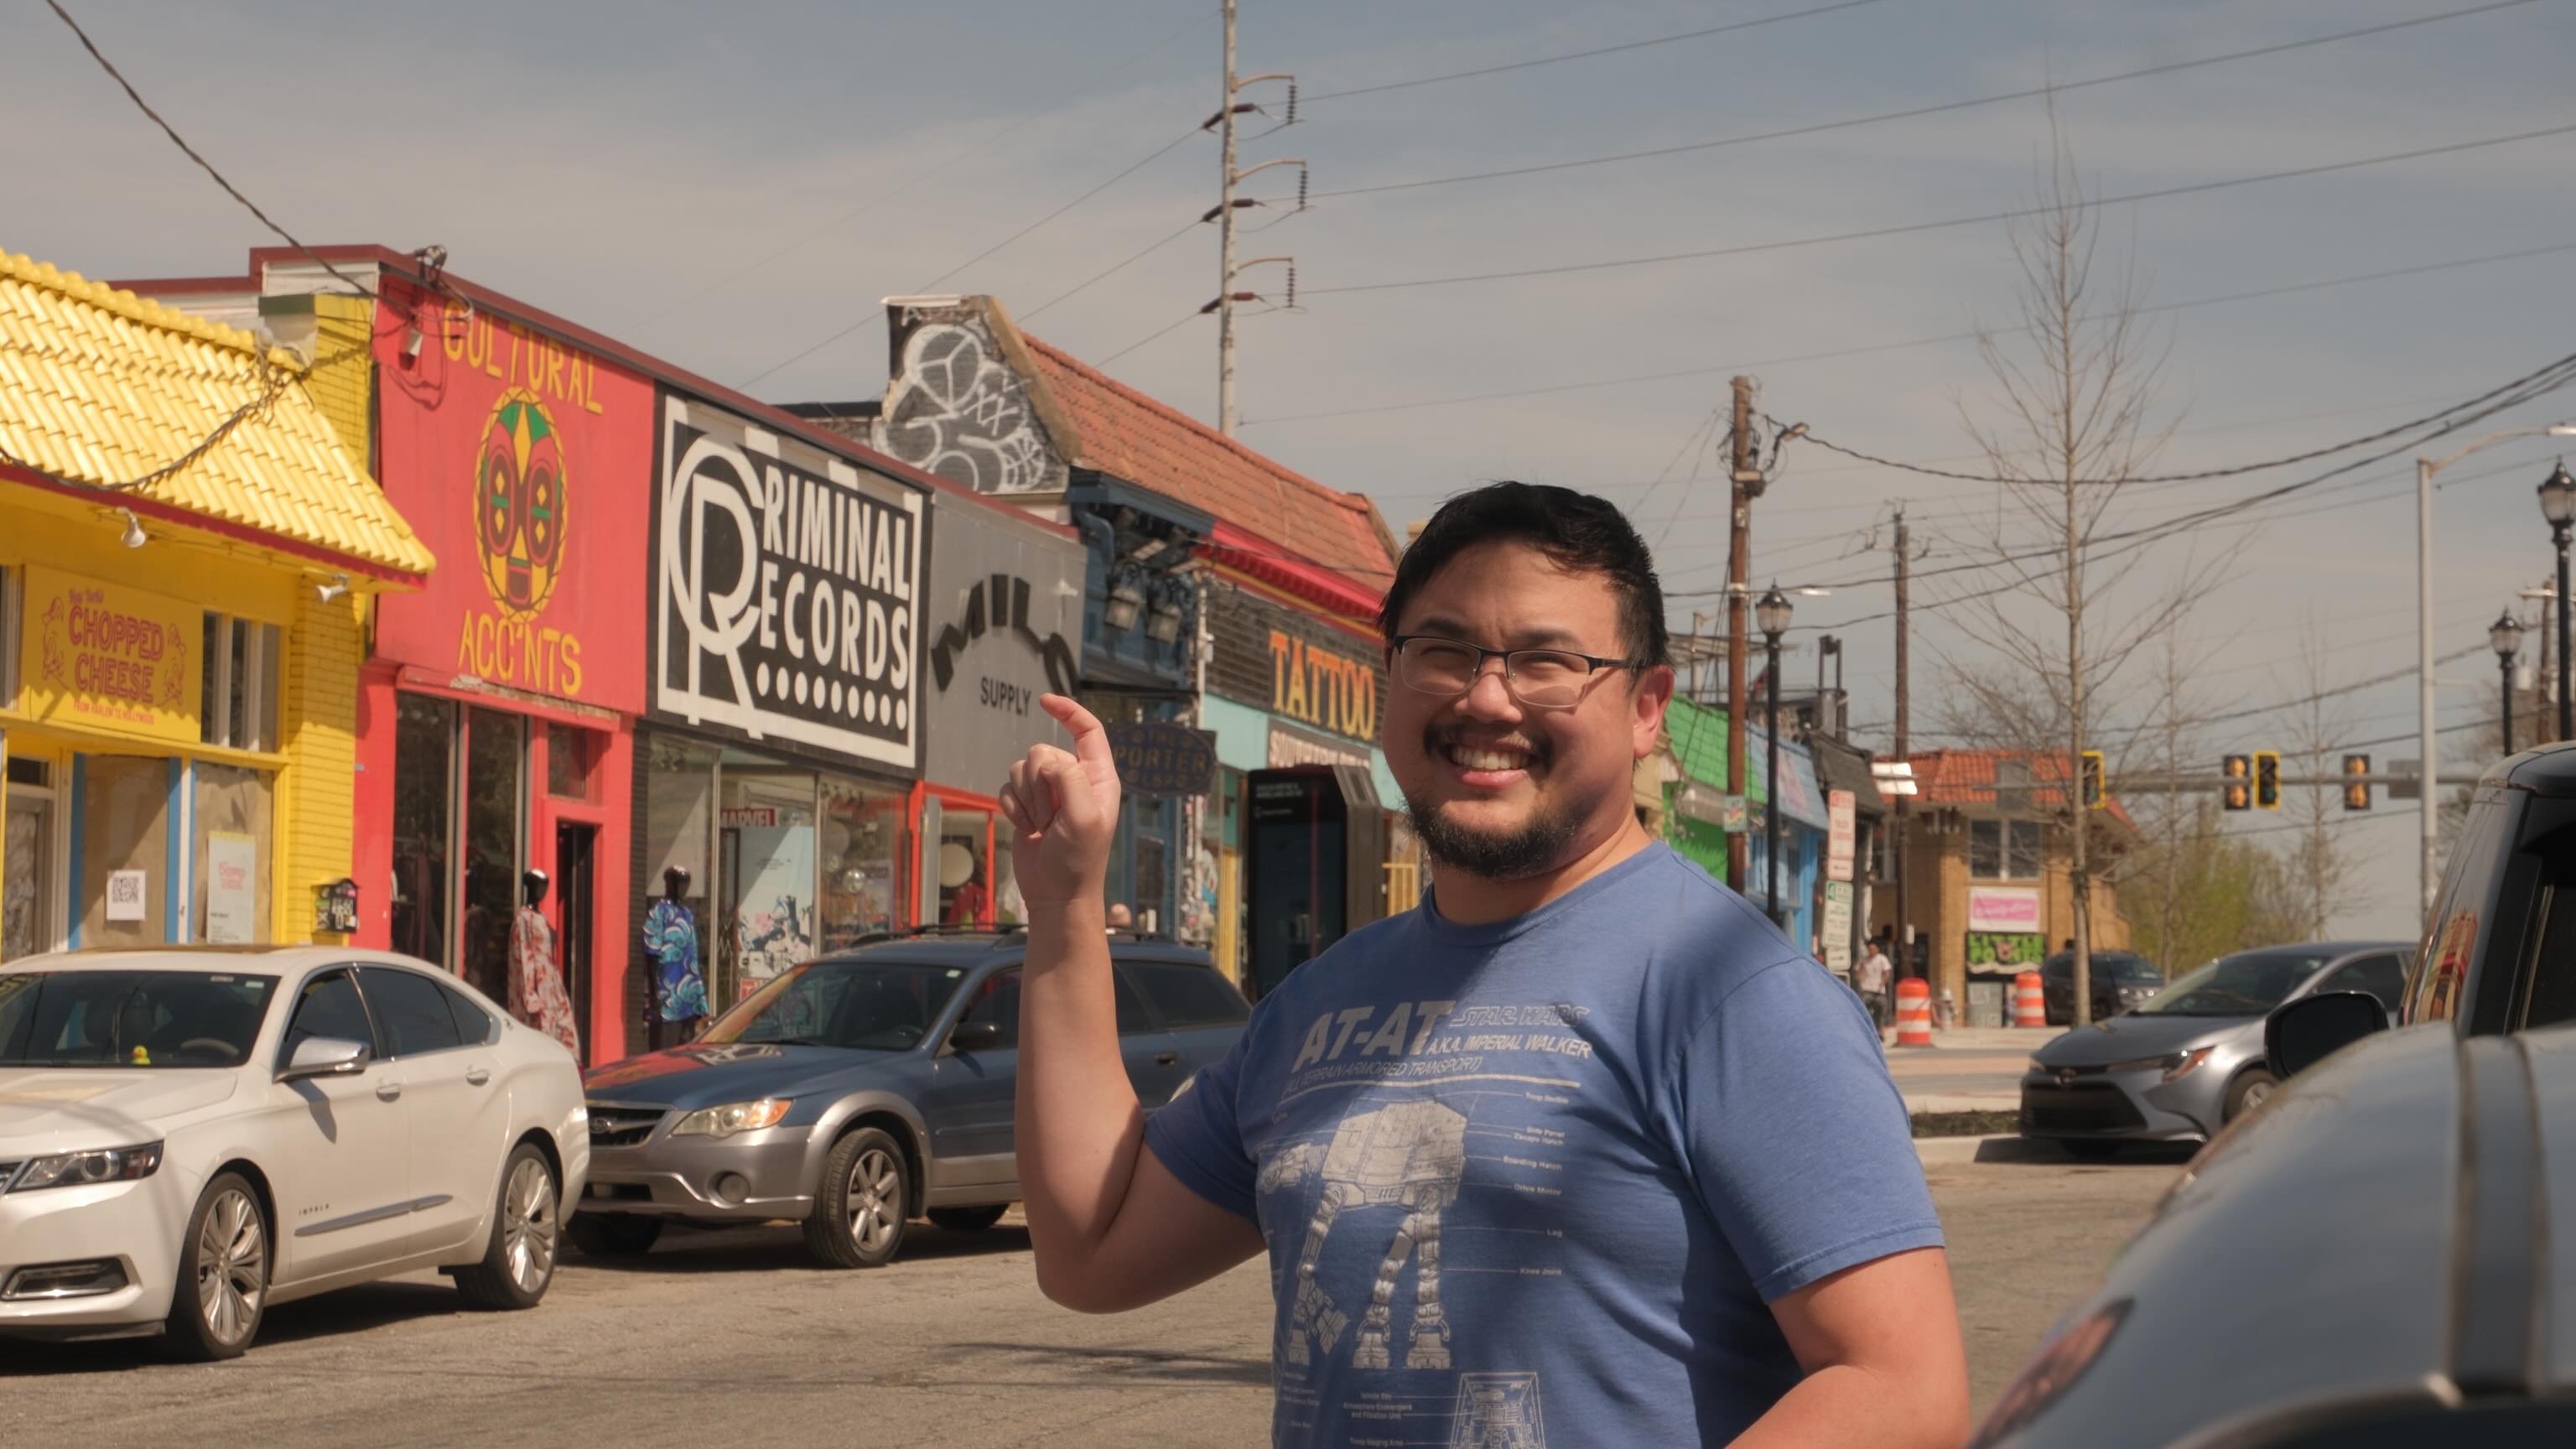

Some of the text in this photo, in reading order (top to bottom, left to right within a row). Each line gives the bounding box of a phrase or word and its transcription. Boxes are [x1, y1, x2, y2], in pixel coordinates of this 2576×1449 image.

[443, 297, 603, 415] CULTURAL
[69, 605, 164, 662] CHOPPED
[75, 652, 154, 704] CHEESE
[980, 677, 1031, 718] SUPPLY
[1269, 630, 1376, 740] TATTOO
[1114, 745, 1208, 771] PORTER
[1291, 1000, 1457, 1074] AT-AT
[1449, 1005, 1590, 1028] STAR WARS
[1466, 1035, 1522, 1052] IMPERIAL
[1524, 1034, 1593, 1060] WALKER
